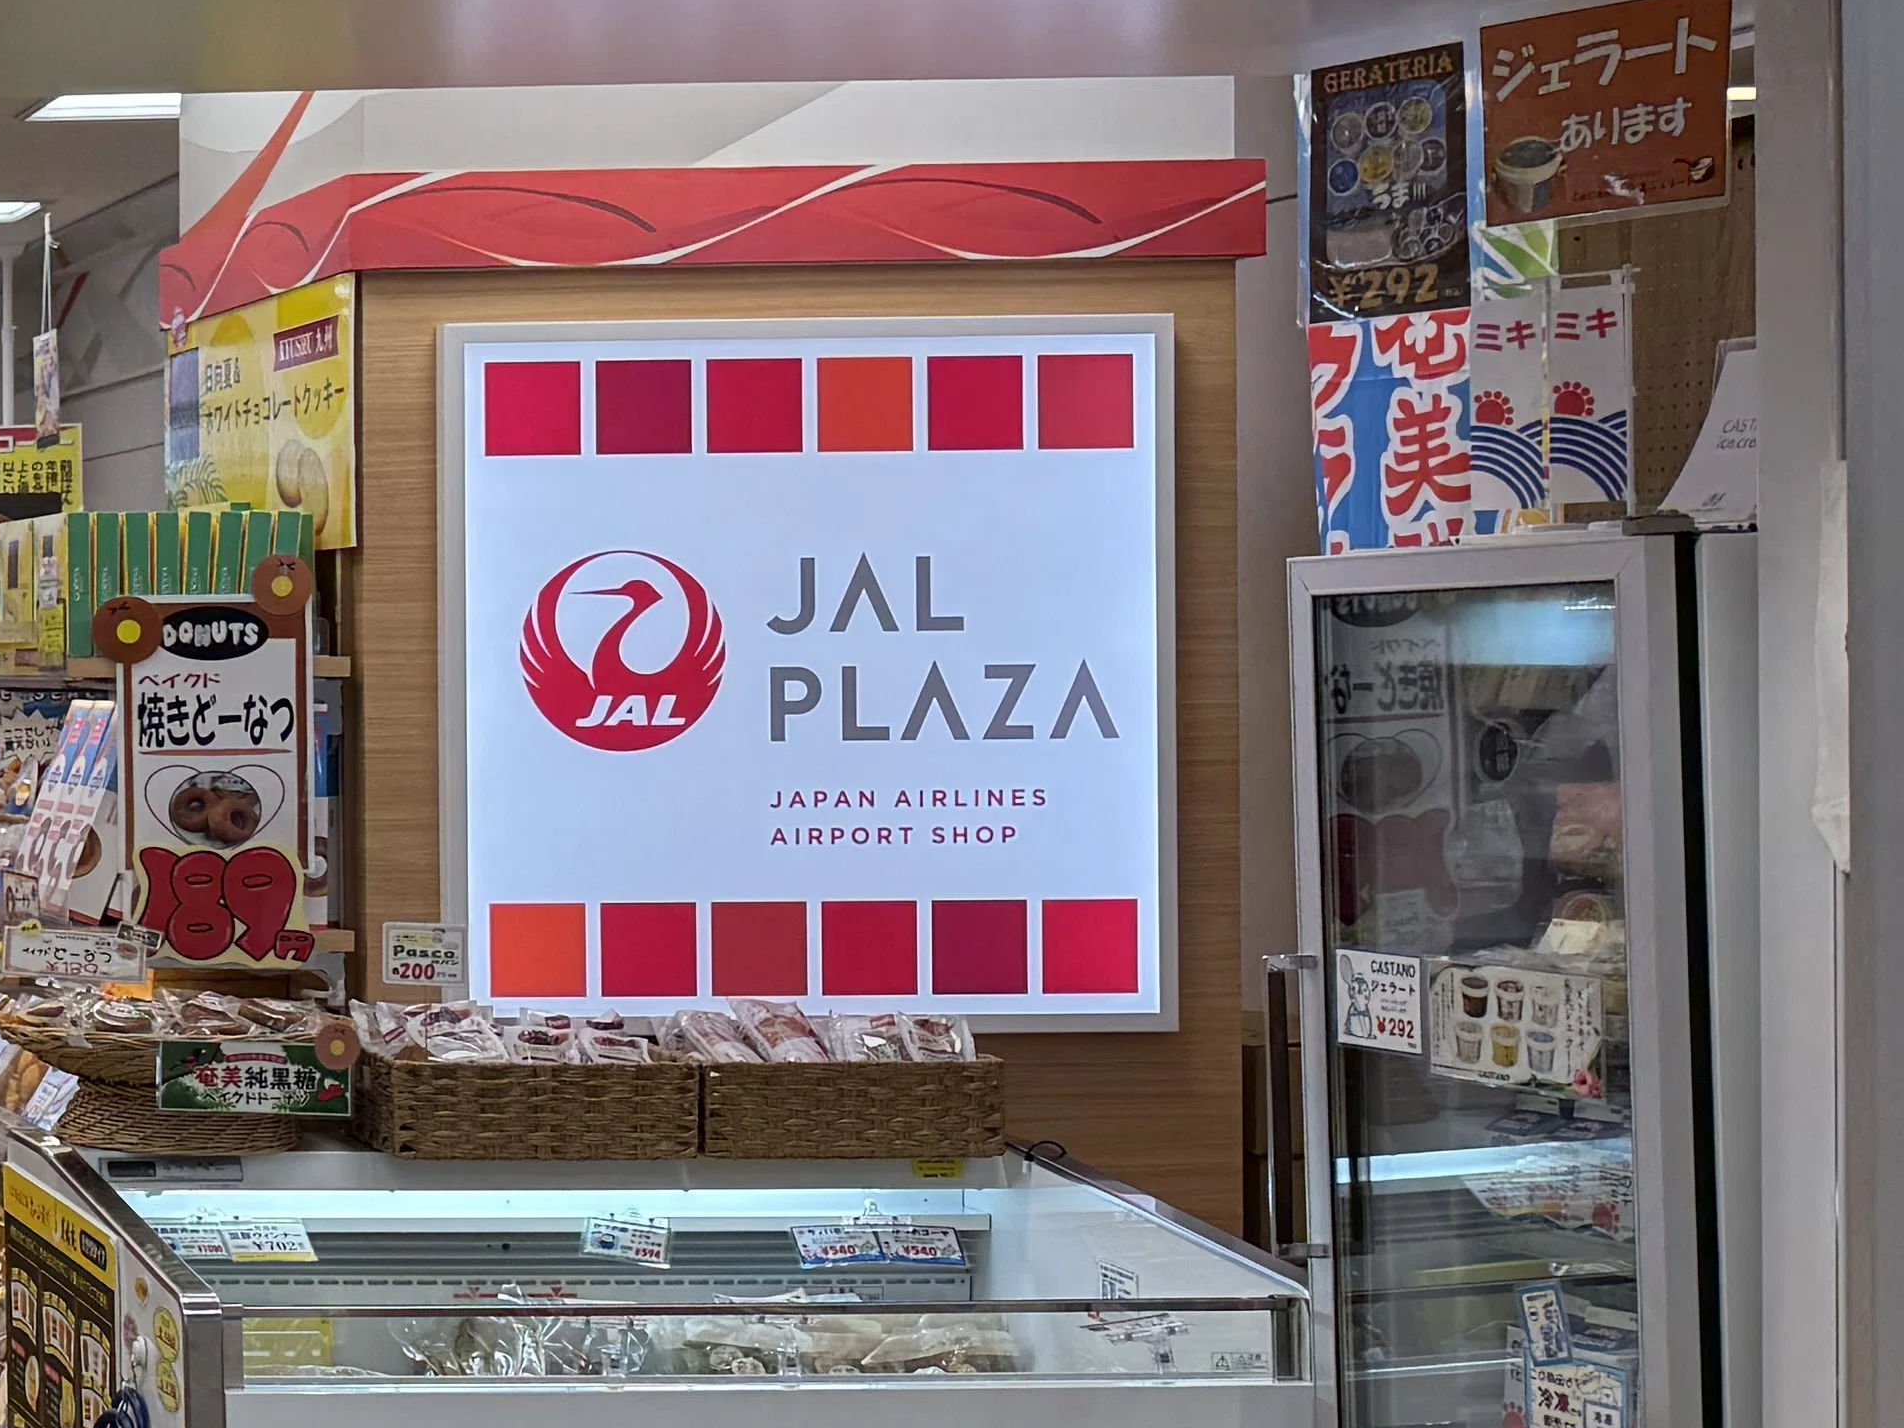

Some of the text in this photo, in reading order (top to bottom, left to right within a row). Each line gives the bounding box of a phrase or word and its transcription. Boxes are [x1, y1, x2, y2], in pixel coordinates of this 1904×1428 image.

[1323, 51, 1454, 94] GERATERIA
[1490, 17, 1718, 101] ジェラート
[1560, 98, 1692, 154] あります
[1475, 321, 1536, 352] ミキ
[1554, 308, 1619, 340] ミキ
[766, 552, 965, 636] JAL
[161, 618, 260, 647] DONUTS
[137, 690, 295, 748] 焼きどーなつ
[576, 694, 686, 728] JAL
[769, 659, 1120, 742] PLAZA
[770, 787, 1048, 809] JAPAN AIRLINES
[770, 825, 1018, 847] AIRPORT SHOP
